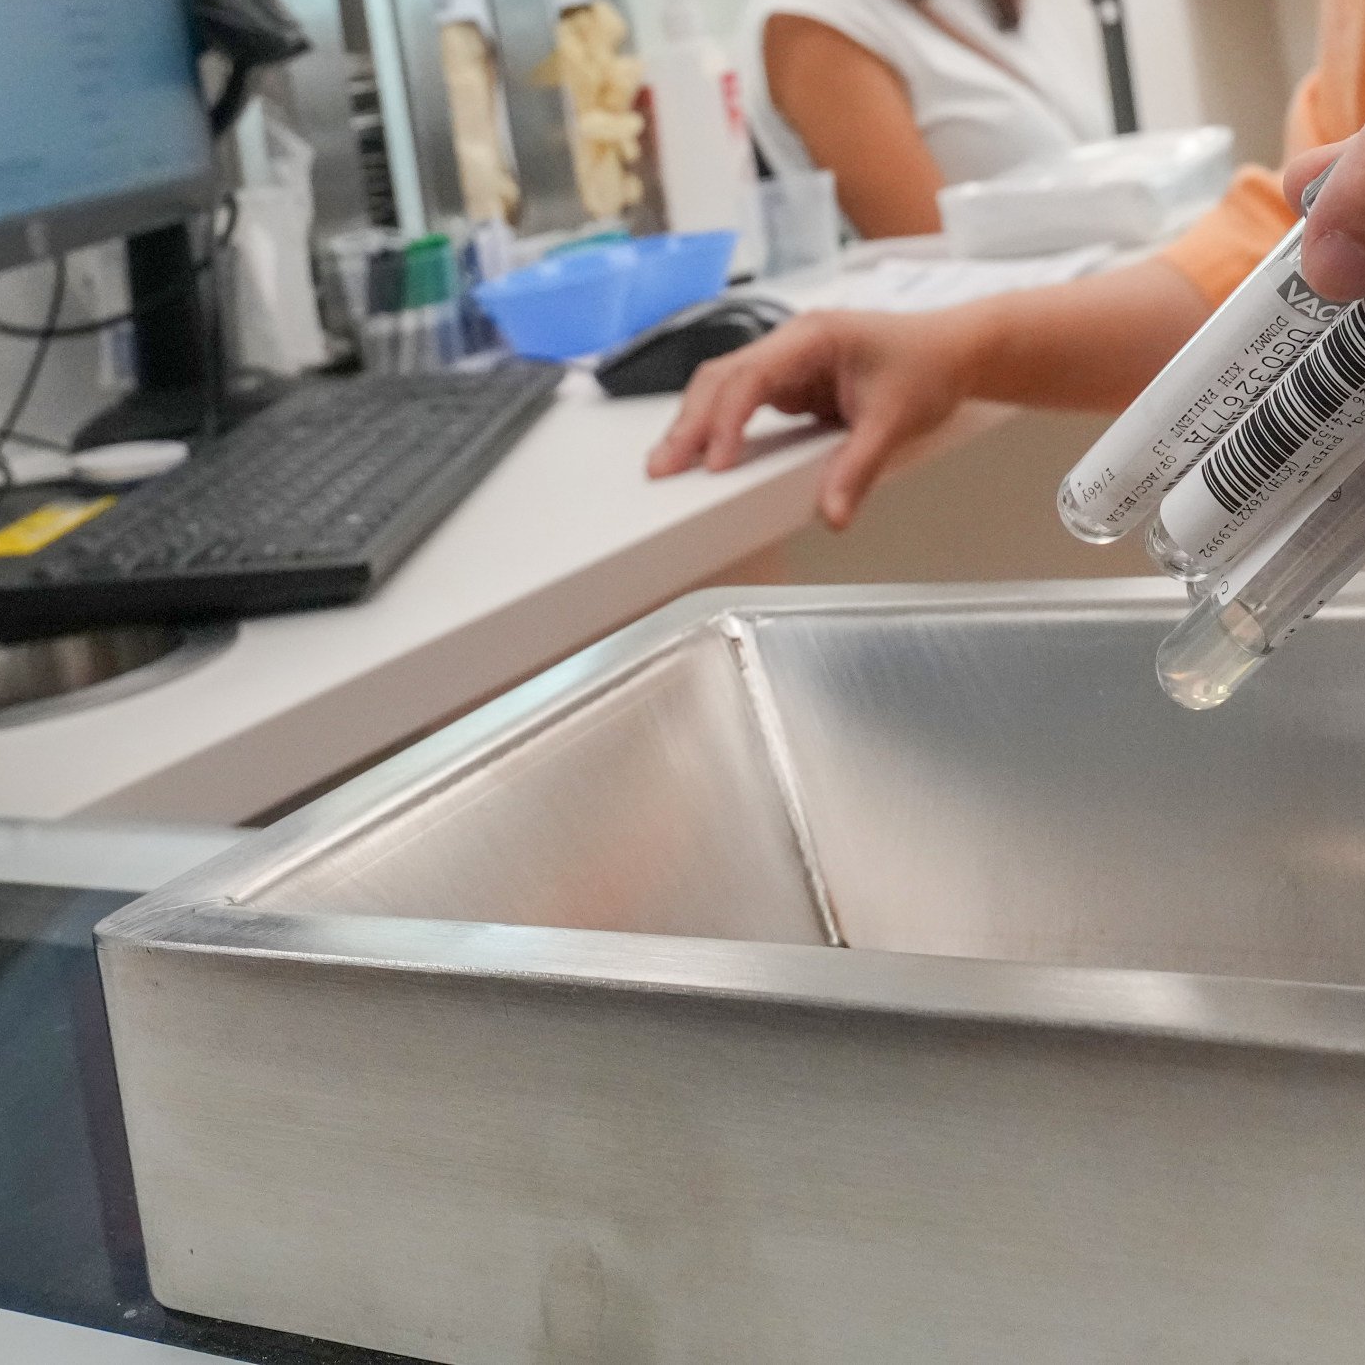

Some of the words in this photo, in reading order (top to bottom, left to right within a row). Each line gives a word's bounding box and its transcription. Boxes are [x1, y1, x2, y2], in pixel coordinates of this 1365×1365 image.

[1241, 314, 1289, 357] DUMMY,
[1182, 324, 1312, 449] UG032677A
[1216, 361, 1244, 387] KTH
[1168, 388, 1219, 438] PATIENT
[1310, 407, 1352, 448] 14:59
[1150, 438, 1171, 457] 13
[1081, 466, 1115, 503] F/66y
